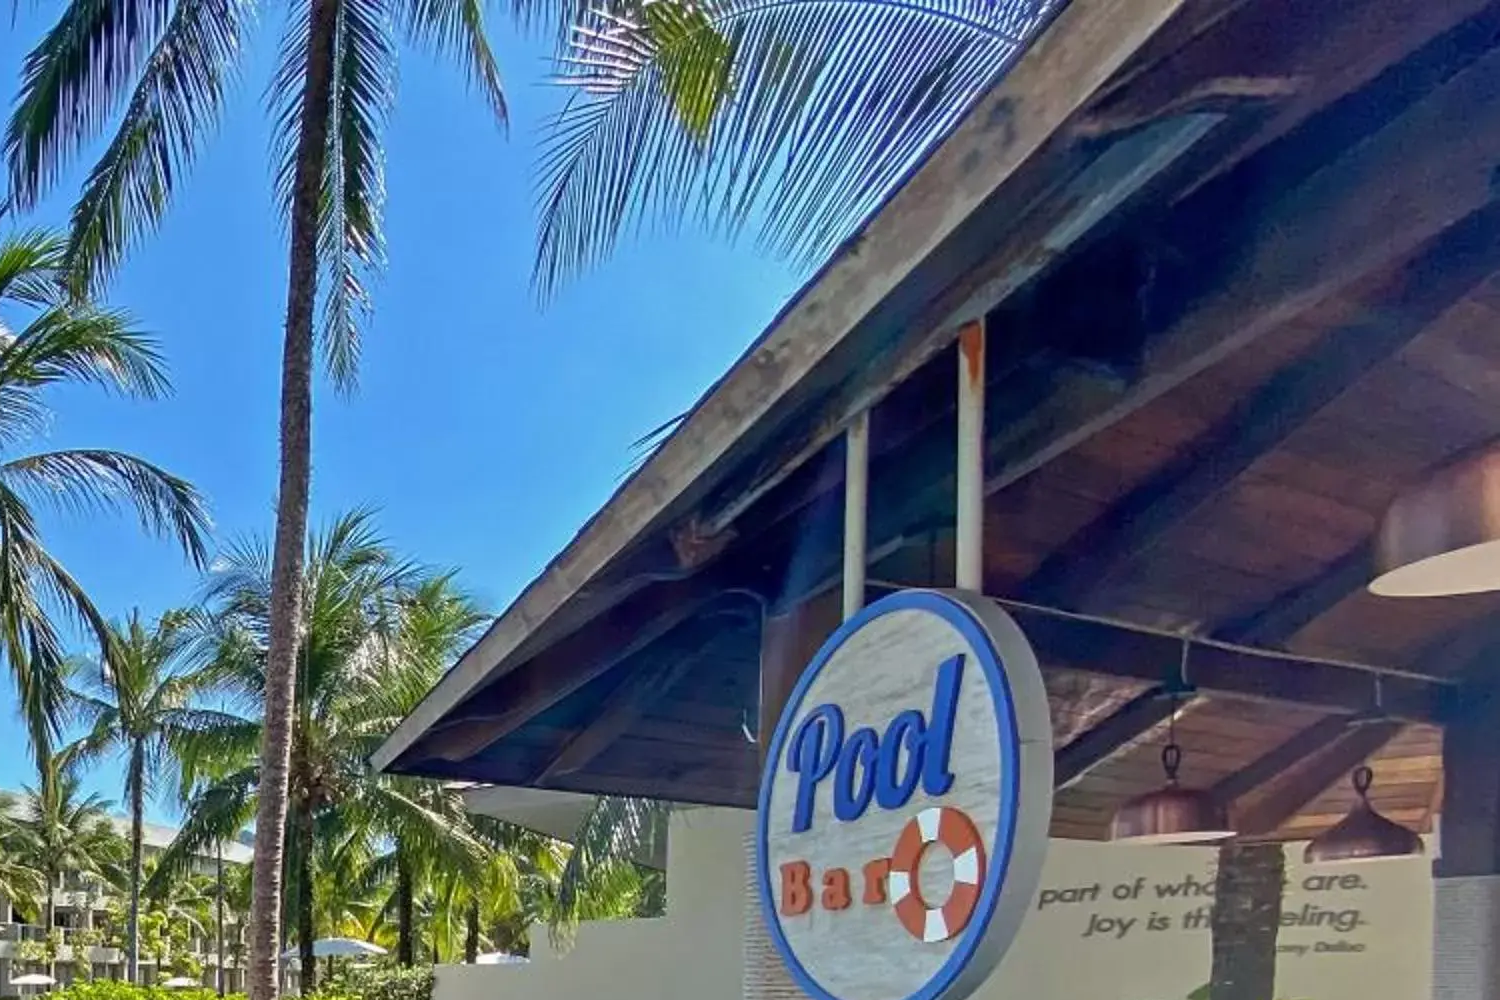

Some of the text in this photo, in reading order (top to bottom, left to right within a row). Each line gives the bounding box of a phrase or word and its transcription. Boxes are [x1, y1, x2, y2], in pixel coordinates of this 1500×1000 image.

[786, 653, 966, 833] Pool
[779, 857, 891, 917] Bar
[1038, 883, 1100, 911] part
[1112, 877, 1147, 900] of
[1302, 873, 1369, 891] are.
[1081, 903, 1369, 939] Joy is th eling.
